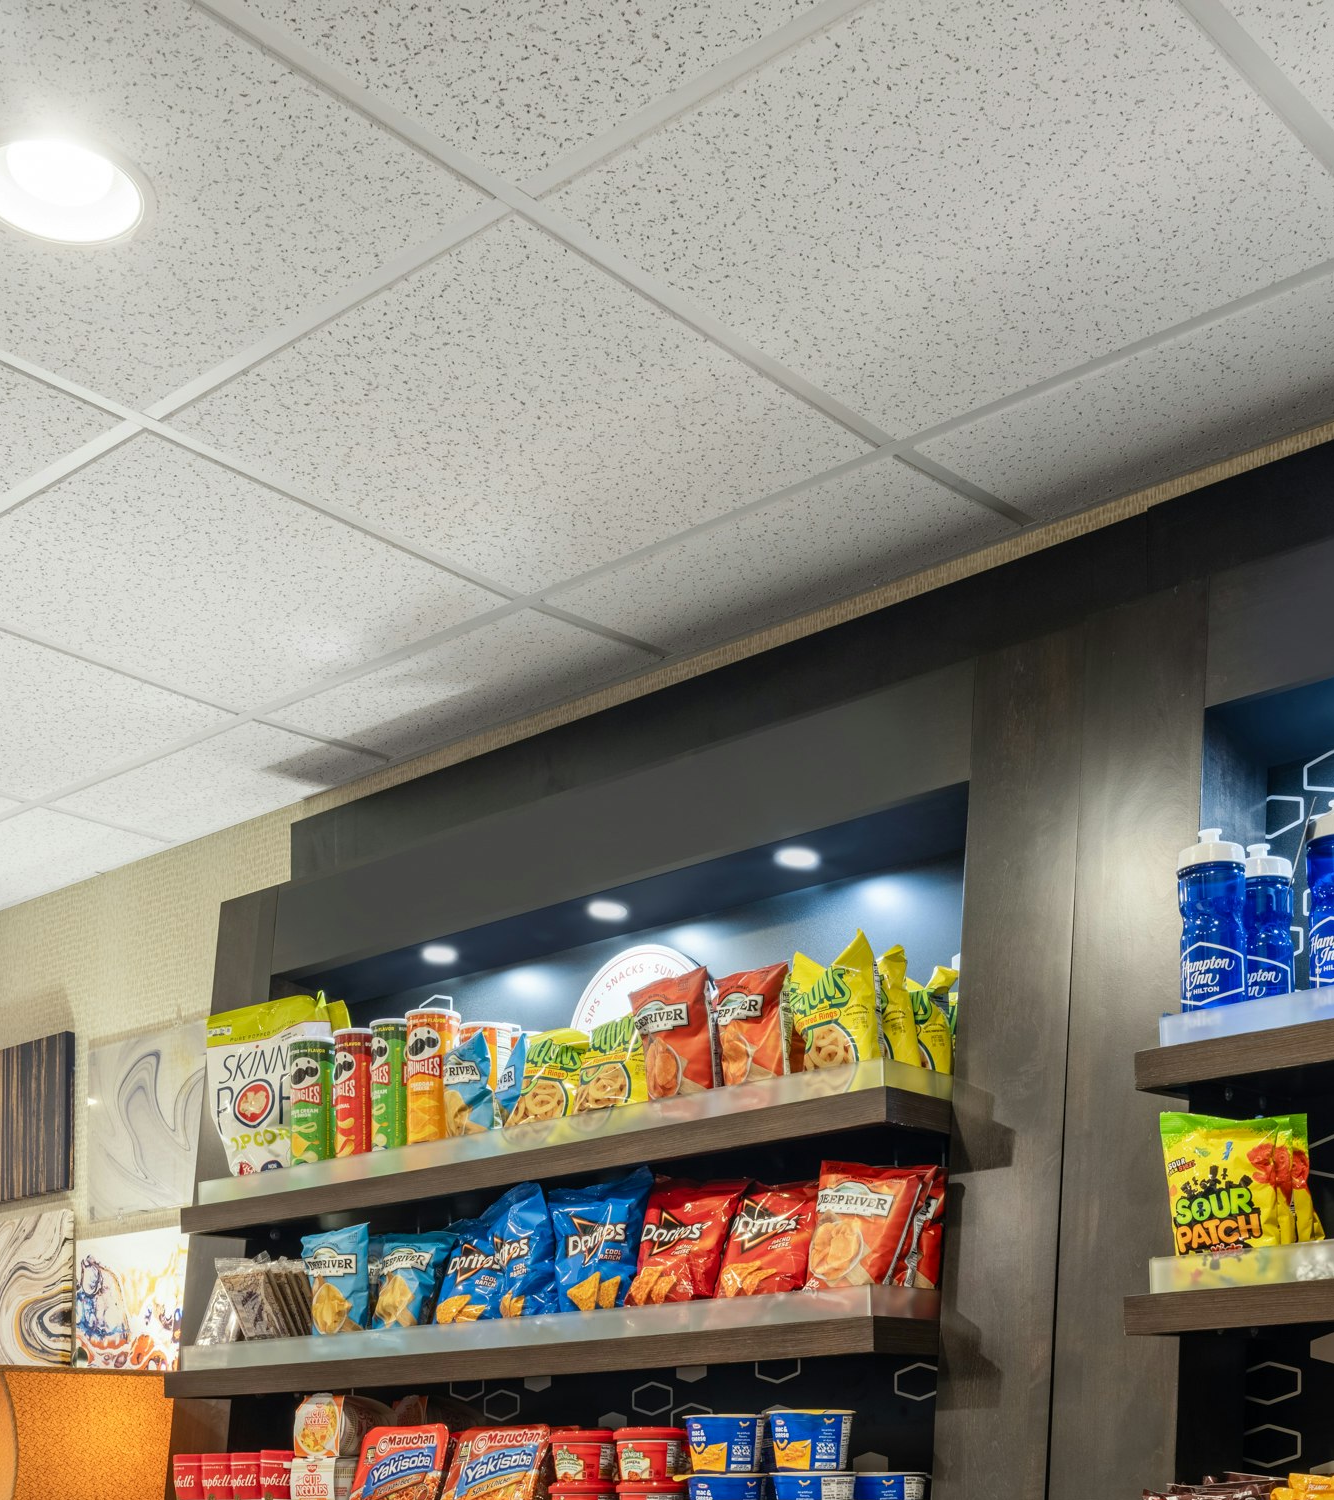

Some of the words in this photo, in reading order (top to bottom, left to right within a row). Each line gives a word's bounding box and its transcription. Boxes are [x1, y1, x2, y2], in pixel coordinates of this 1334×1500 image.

[1181, 957, 1235, 981] Hampton
[1185, 972, 1219, 990] Inn
[585, 999, 601, 1025] SIPS
[605, 963, 645, 991] SNACKS
[1193, 985, 1220, 995] HILTON
[649, 1007, 685, 1024] RIVER
[819, 1010, 838, 1021] Rings
[407, 1056, 441, 1077] PRINGLES
[449, 1066, 479, 1078] RIVER
[1167, 1157, 1186, 1171] SOUR
[847, 1194, 888, 1212] RIVER
[1175, 1187, 1253, 1225] SOUR
[641, 1221, 704, 1242] Doritos
[730, 1214, 797, 1238] Doritos
[1176, 1213, 1263, 1254] PATCH
[569, 1222, 627, 1258] Doritos
[768, 1242, 791, 1250] CHEESE
[771, 1236, 792, 1246] NACHO
[605, 1248, 622, 1256] COOL
[670, 1248, 691, 1257] CHEESE
[675, 1243, 695, 1252] NACHO
[397, 1254, 426, 1266] RIVER
[599, 1253, 622, 1261] RANCH
[323, 1258, 353, 1270] RIVER
[448, 1256, 501, 1275] Doritos
[512, 1263, 526, 1271] COOL
[481, 1274, 497, 1282] COOL
[509, 1268, 527, 1278] RANCH
[475, 1279, 497, 1287] RANCH
[388, 1434, 435, 1446] Maruchan
[487, 1430, 540, 1445] Maruchan
[371, 1452, 432, 1484] Yakisoba
[465, 1451, 532, 1483] Yakisoba
[302, 1475, 321, 1485] CUP
[295, 1484, 329, 1497] NOODLES
